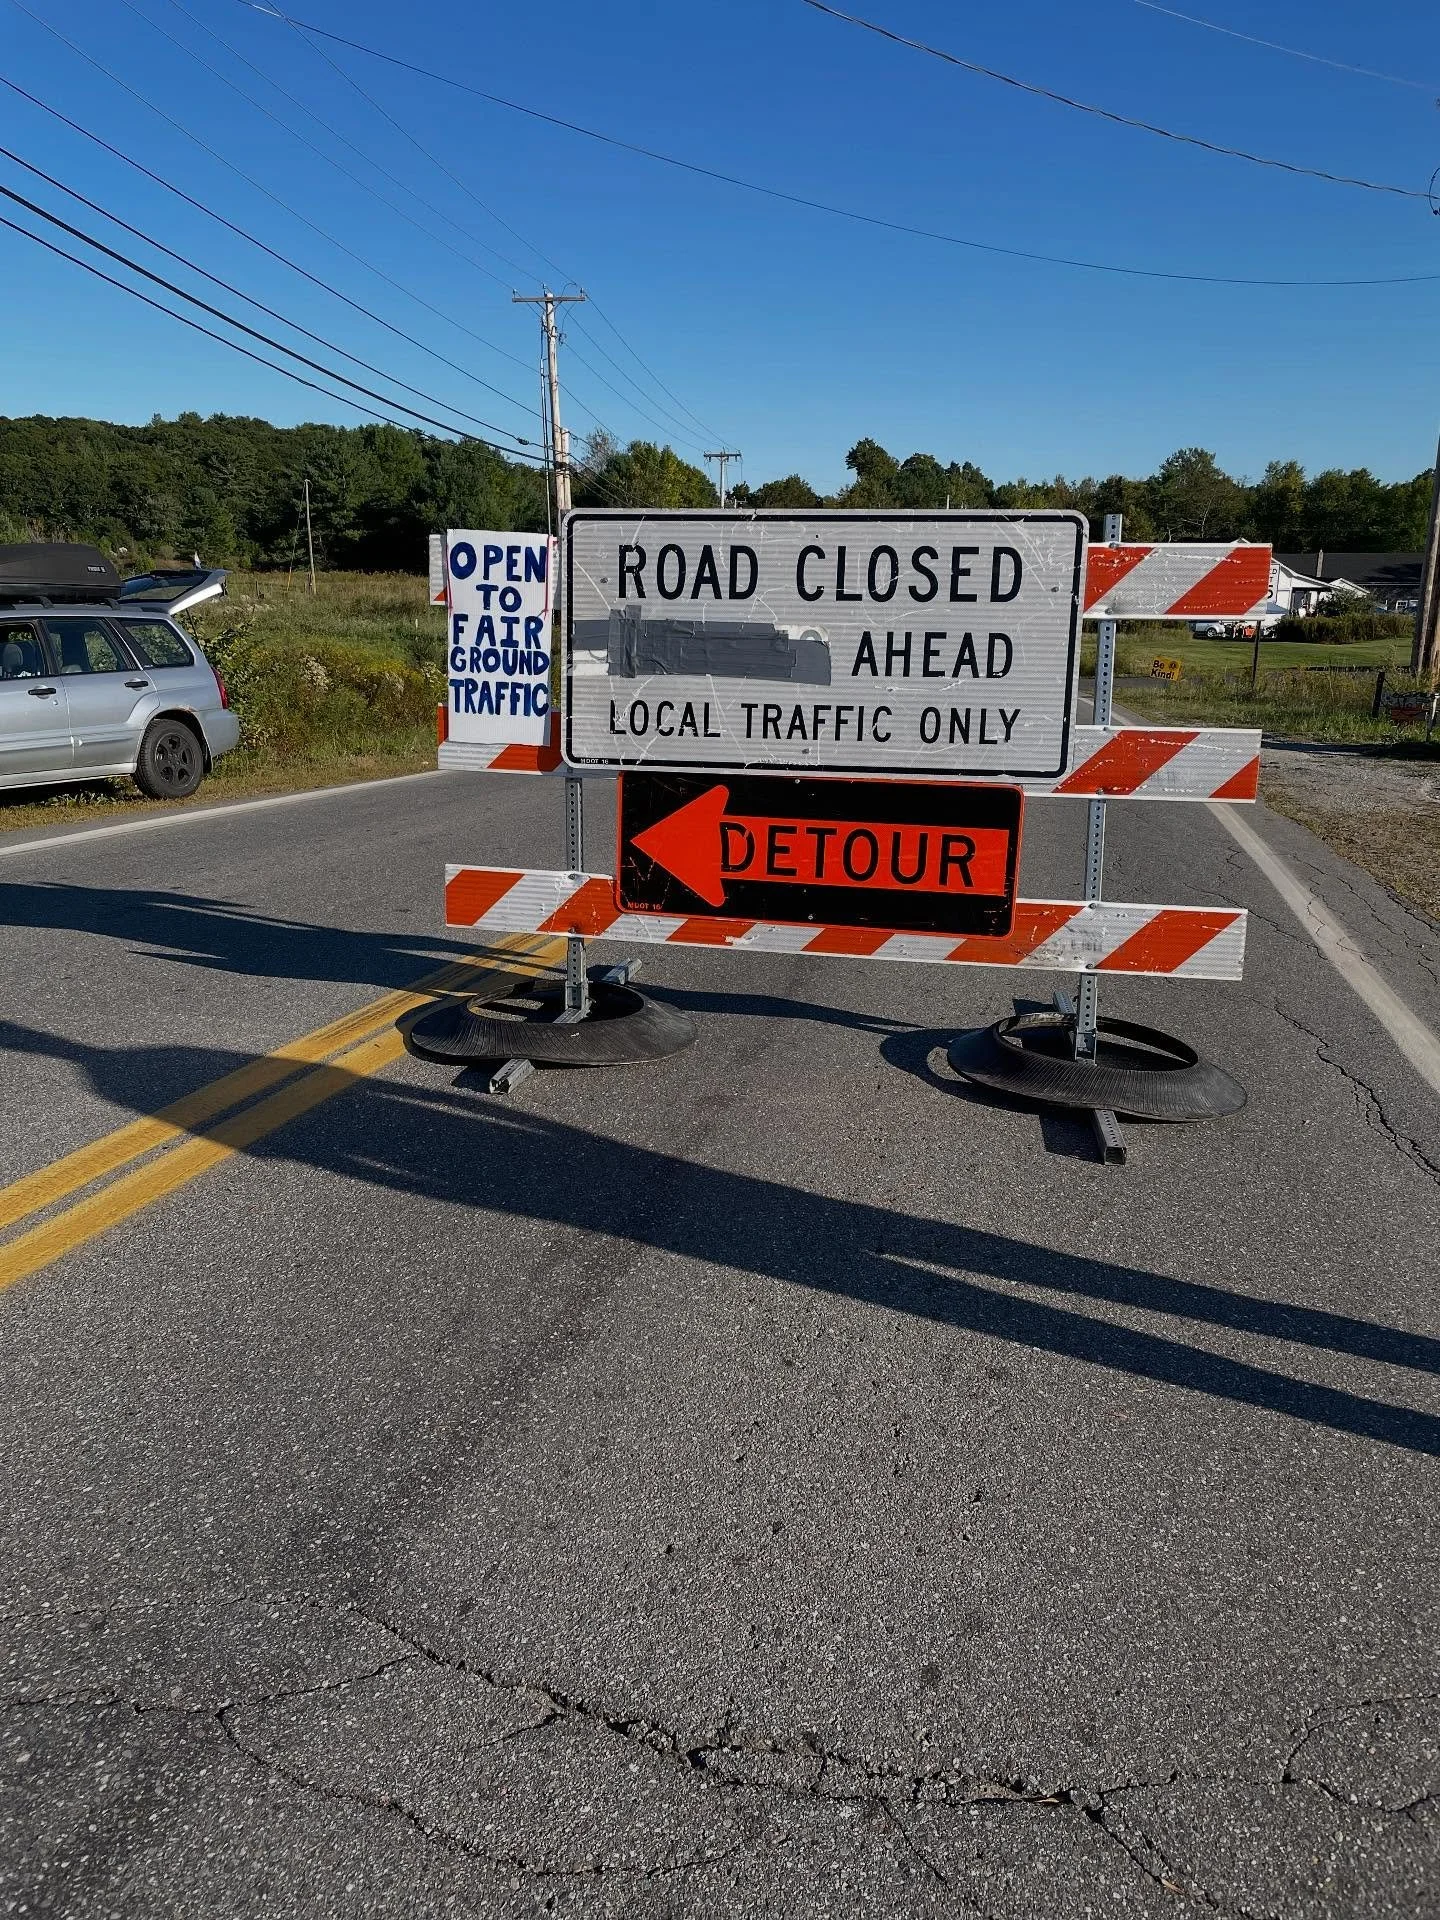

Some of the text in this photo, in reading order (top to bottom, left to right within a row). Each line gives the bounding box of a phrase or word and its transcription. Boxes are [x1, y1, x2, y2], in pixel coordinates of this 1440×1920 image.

[450, 541, 547, 583] OPEN
[618, 543, 1023, 603] ROAD CLOSED
[476, 583, 522, 613] TO
[453, 613, 544, 649] FAIR
[450, 646, 550, 676] GROUND
[851, 630, 1013, 679] AHEAD
[1150, 668, 1175, 680] Kind!
[1152, 659, 1165, 669] Be
[449, 677, 550, 718] TRAFFIC
[609, 699, 1021, 745] LOCAL TRAFFIC ONLY
[720, 821, 976, 889] DETOUR
